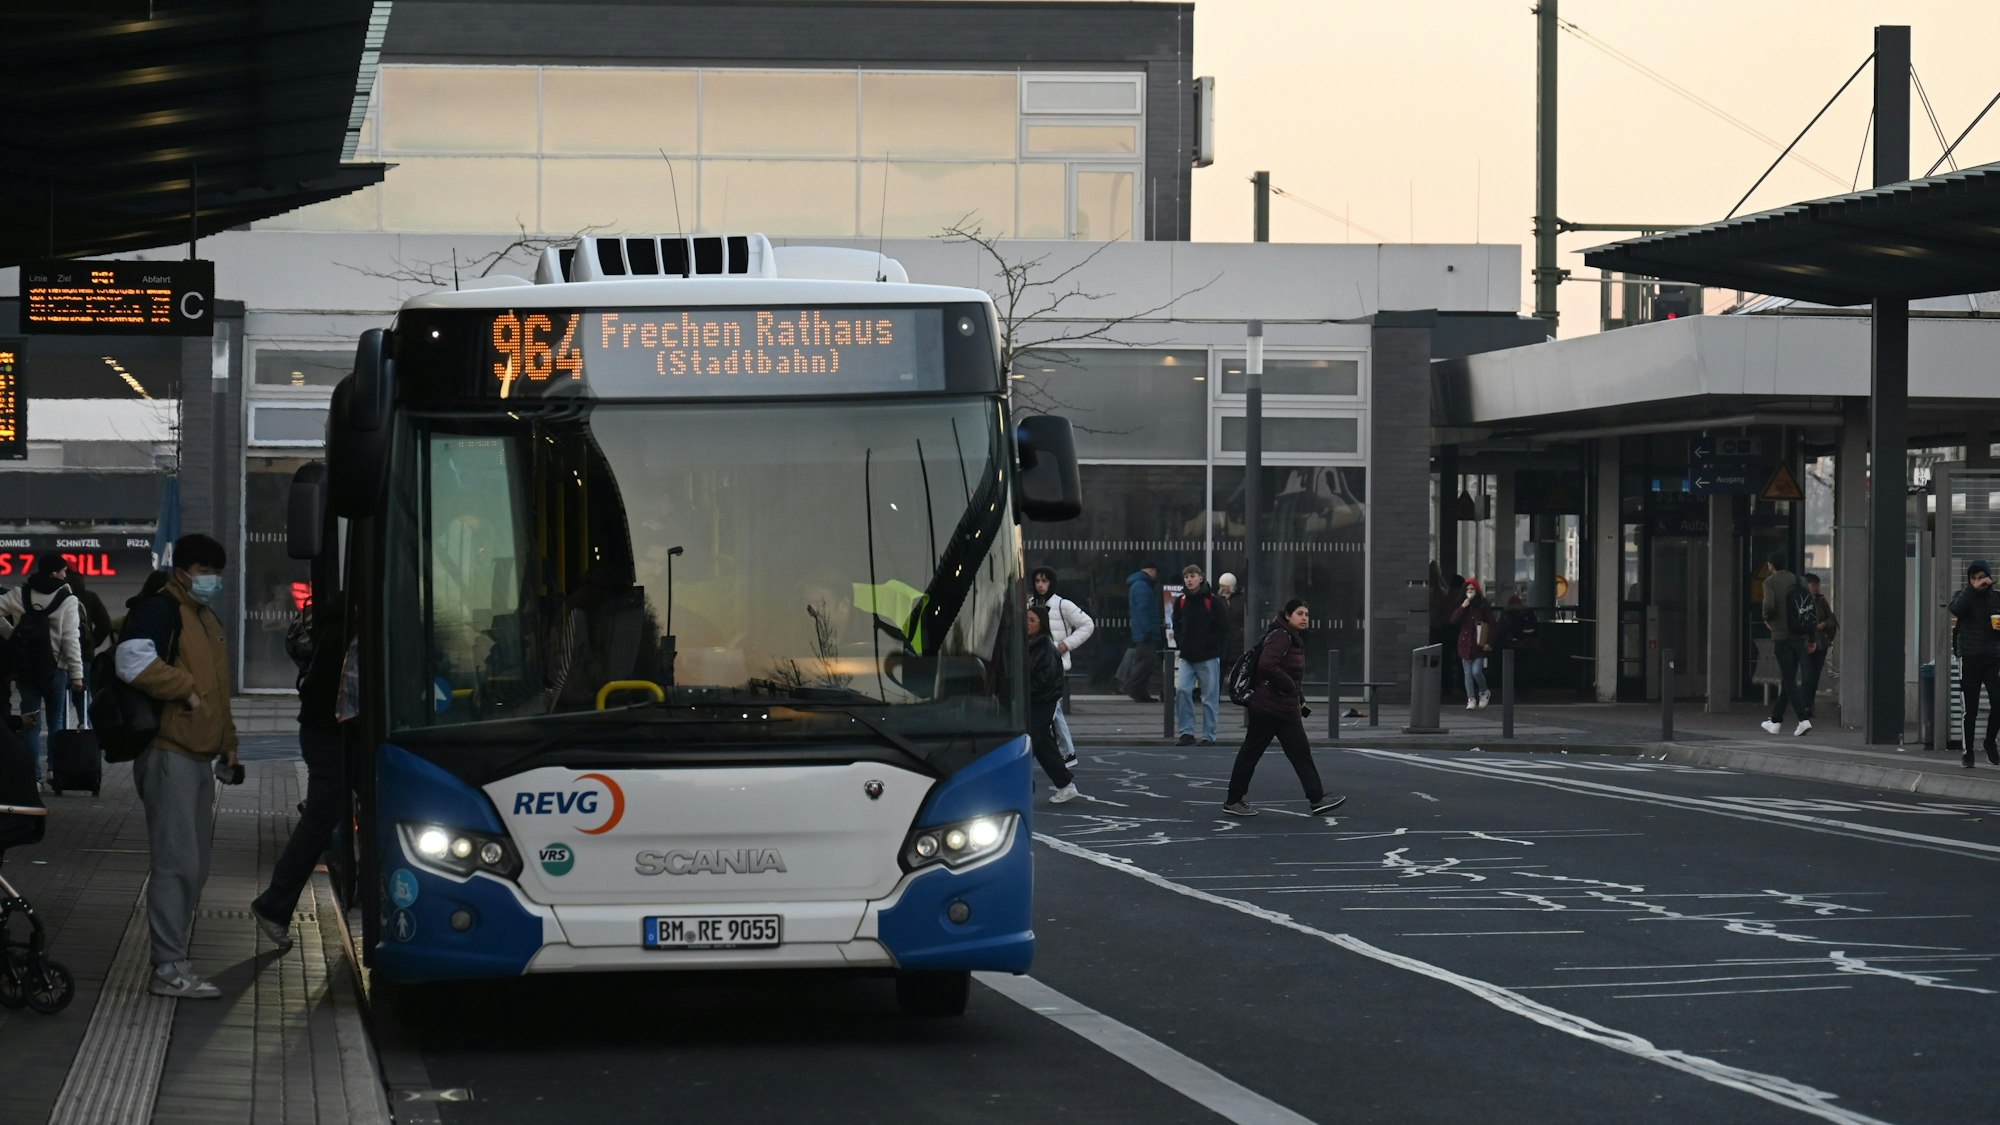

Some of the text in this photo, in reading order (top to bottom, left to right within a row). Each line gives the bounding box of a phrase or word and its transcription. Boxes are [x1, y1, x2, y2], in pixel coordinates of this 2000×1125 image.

[29, 274, 171, 284] Linie Ziel Abfahrt
[180, 291, 204, 320] C
[493, 311, 894, 381] 964 Frechen Rathaus
[656, 349, 840, 376] (Stadtbahn)
[1716, 475, 1745, 484] Ausgang
[56, 538, 101, 548] SCHNITZEL
[126, 538, 150, 548] PIZZA
[513, 791, 599, 815] REVG
[539, 849, 566, 861] VRS
[635, 848, 788, 876] SCANIA
[659, 920, 684, 942] BM
[698, 920, 723, 941] RE
[729, 919, 776, 941] 9055
